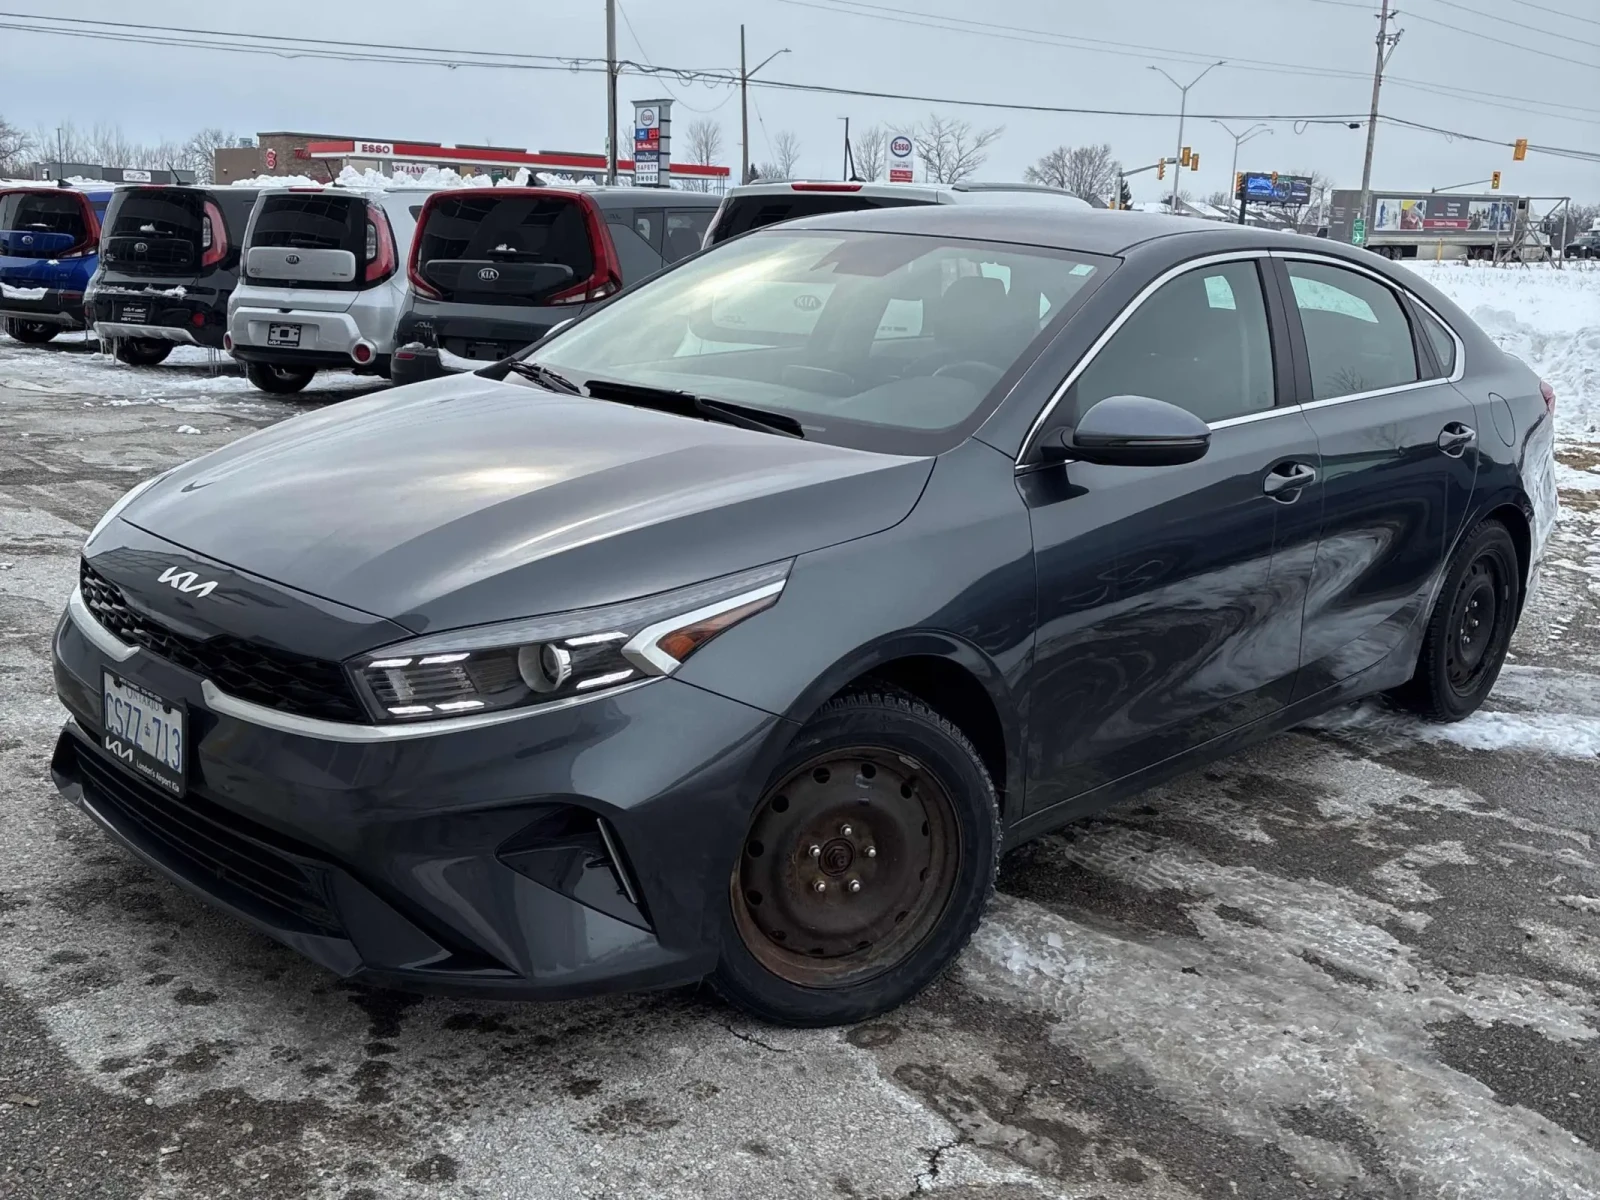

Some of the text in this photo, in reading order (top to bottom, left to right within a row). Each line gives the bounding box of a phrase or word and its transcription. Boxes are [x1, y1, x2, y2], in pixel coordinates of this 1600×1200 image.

[642, 113, 653, 122] Esso
[361, 143, 391, 154] ESSO
[893, 141, 910, 151] Esso
[480, 270, 496, 280] KIA
[796, 296, 817, 308] KIA
[157, 565, 219, 598] KIA
[105, 735, 134, 763] KIA
[152, 716, 182, 771] 713
[136, 758, 180, 793] London's Airport Kia
